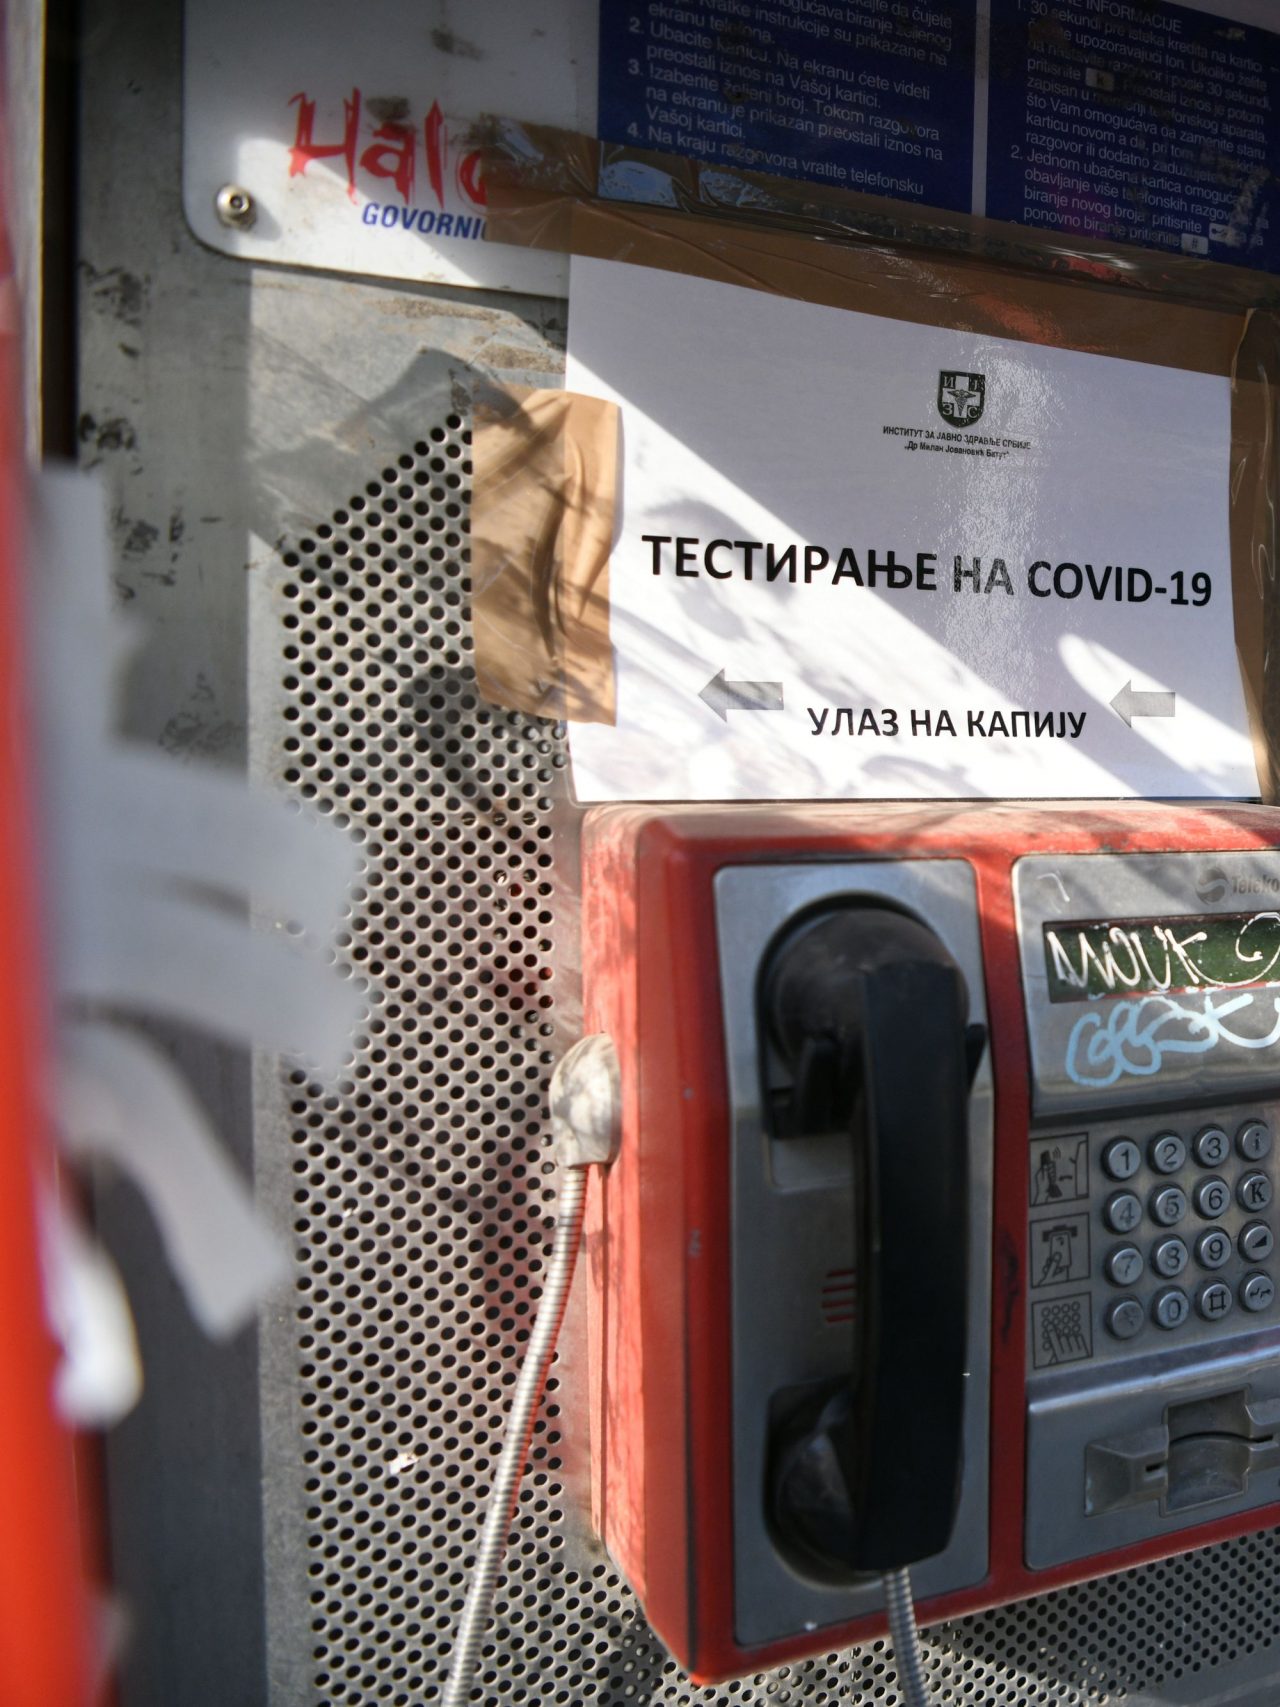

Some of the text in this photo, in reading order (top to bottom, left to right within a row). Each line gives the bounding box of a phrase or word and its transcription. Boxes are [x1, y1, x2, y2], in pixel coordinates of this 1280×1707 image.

[648, 3, 705, 27] ekranu
[846, 8, 894, 34] biranje
[891, 3, 909, 17] da
[912, 7, 953, 29] čujete
[1031, 0, 1049, 16] 30
[1210, 49, 1226, 63] na
[755, 4, 830, 38] instrukcije
[833, 27, 853, 43] su
[855, 32, 926, 59] prikazane
[929, 53, 947, 66] na
[1075, 32, 1162, 64] upozoravajući
[628, 16, 931, 101] 2. Ubacite Na ekranu ćete videti
[646, 44, 881, 109] preostali iznos na Vašoj kartici.
[627, 58, 644, 76] 3.
[649, 62, 720, 92] Izaberite
[776, 91, 809, 115] broj.
[813, 98, 866, 124] Tokom
[1026, 76, 1078, 97] zapisan
[1081, 89, 1090, 101] u
[1206, 81, 1223, 97] 30
[645, 103, 747, 138] Vašoj kartici.
[646, 86, 943, 161] na ekranu je prikazan preostali iznos na
[1026, 94, 1047, 109] što
[1050, 97, 1082, 117] Vam
[1083, 107, 1158, 135] omogućava
[1236, 142, 1266, 160] staru
[1026, 110, 1069, 133] karticu
[1072, 123, 1116, 144] novom
[1118, 134, 1128, 146] a
[626, 121, 643, 139] 4.
[648, 125, 673, 145] Na
[676, 131, 717, 155] kraju
[720, 144, 798, 171] razgovora
[801, 159, 848, 180] vratite
[850, 167, 924, 196] telefonsku
[1025, 132, 1084, 155] razgovor
[1086, 142, 1096, 157] ili
[1098, 147, 1151, 168] dodatno
[1010, 144, 1024, 160] 2.
[1027, 148, 1080, 172] Jednom
[1083, 162, 1139, 185] ubačena
[1141, 175, 1182, 194] kartica
[1024, 168, 1091, 194] obavljanje
[1093, 181, 1120, 198] više
[361, 202, 487, 241] GOVORNI
[1023, 207, 1081, 228] ponovno
[1083, 215, 1127, 237] biranje
[1024, 185, 1069, 209] biranje
[1071, 198, 1112, 218] novog
[1152, 214, 1203, 234] pritisnite
[882, 425, 924, 438] ИНСТИТУТ
[924, 431, 936, 440] ЗА
[936, 432, 963, 443] ЈАВНО
[919, 442, 944, 452] Милан
[642, 535, 1212, 606] ТЕСТИРАЊЕ НА COVID-19
[807, 707, 1087, 738] УЛАЗ НА КАПИЈУ
[1120, 1149, 1130, 1171] 1
[1163, 1143, 1177, 1165] 2
[1207, 1137, 1221, 1159] 3
[1119, 1182, 1265, 1224] 4 5 6 K
[1121, 1254, 1136, 1277] 7
[1209, 1239, 1223, 1262] 9
[1167, 1299, 1181, 1322] 0
